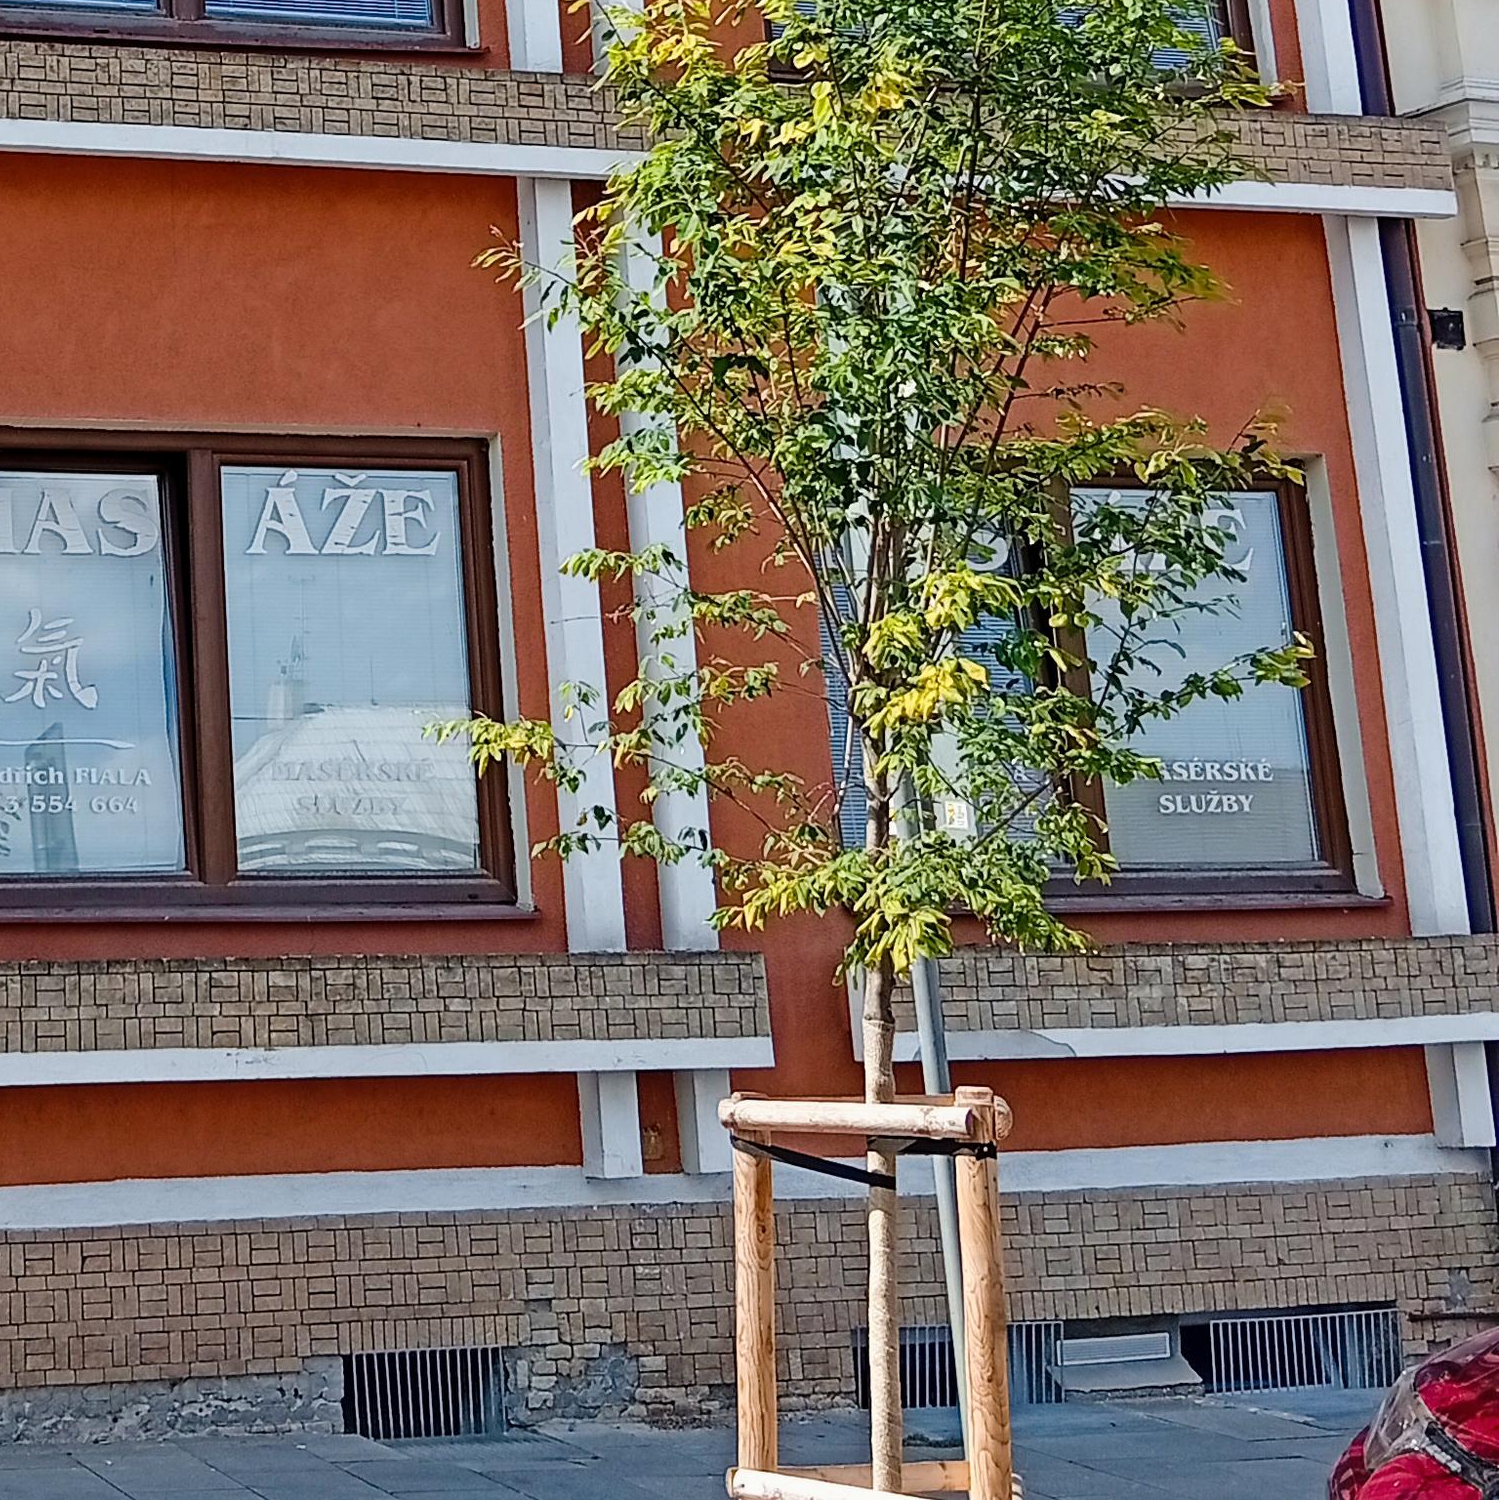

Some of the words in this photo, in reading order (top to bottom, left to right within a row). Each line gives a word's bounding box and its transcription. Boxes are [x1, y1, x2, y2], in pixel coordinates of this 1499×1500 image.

[245, 469, 441, 557] ÁŽE
[75, 766, 152, 785] FIALA
[31, 795, 77, 814] 554
[90, 795, 139, 814] 664
[1158, 790, 1254, 814] SLUŽBY
